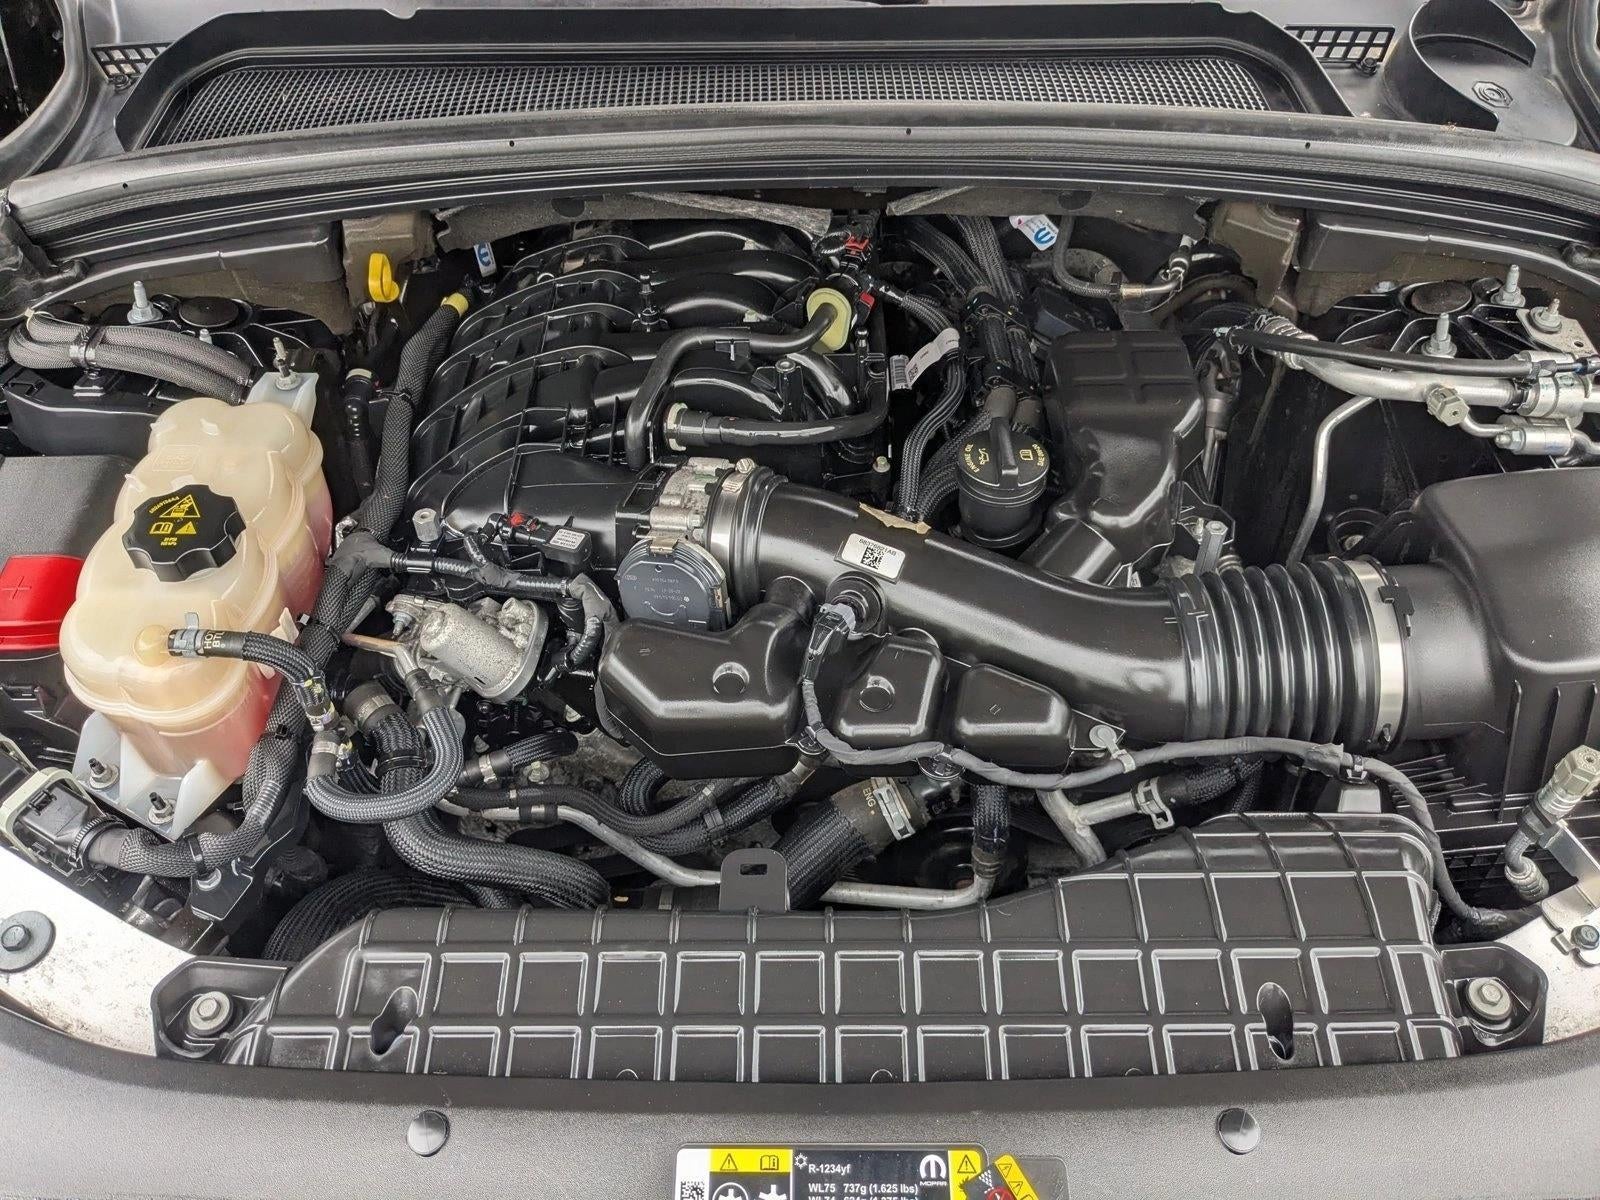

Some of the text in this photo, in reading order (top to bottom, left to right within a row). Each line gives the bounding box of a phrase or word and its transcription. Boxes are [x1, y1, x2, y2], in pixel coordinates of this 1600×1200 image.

[964, 444, 980, 473] ENGINE OIL
[863, 787, 876, 807] ENG
[808, 1163, 851, 1176] R-1234yf
[808, 1183, 918, 1195] WL75 737g (1.625 lbs)
